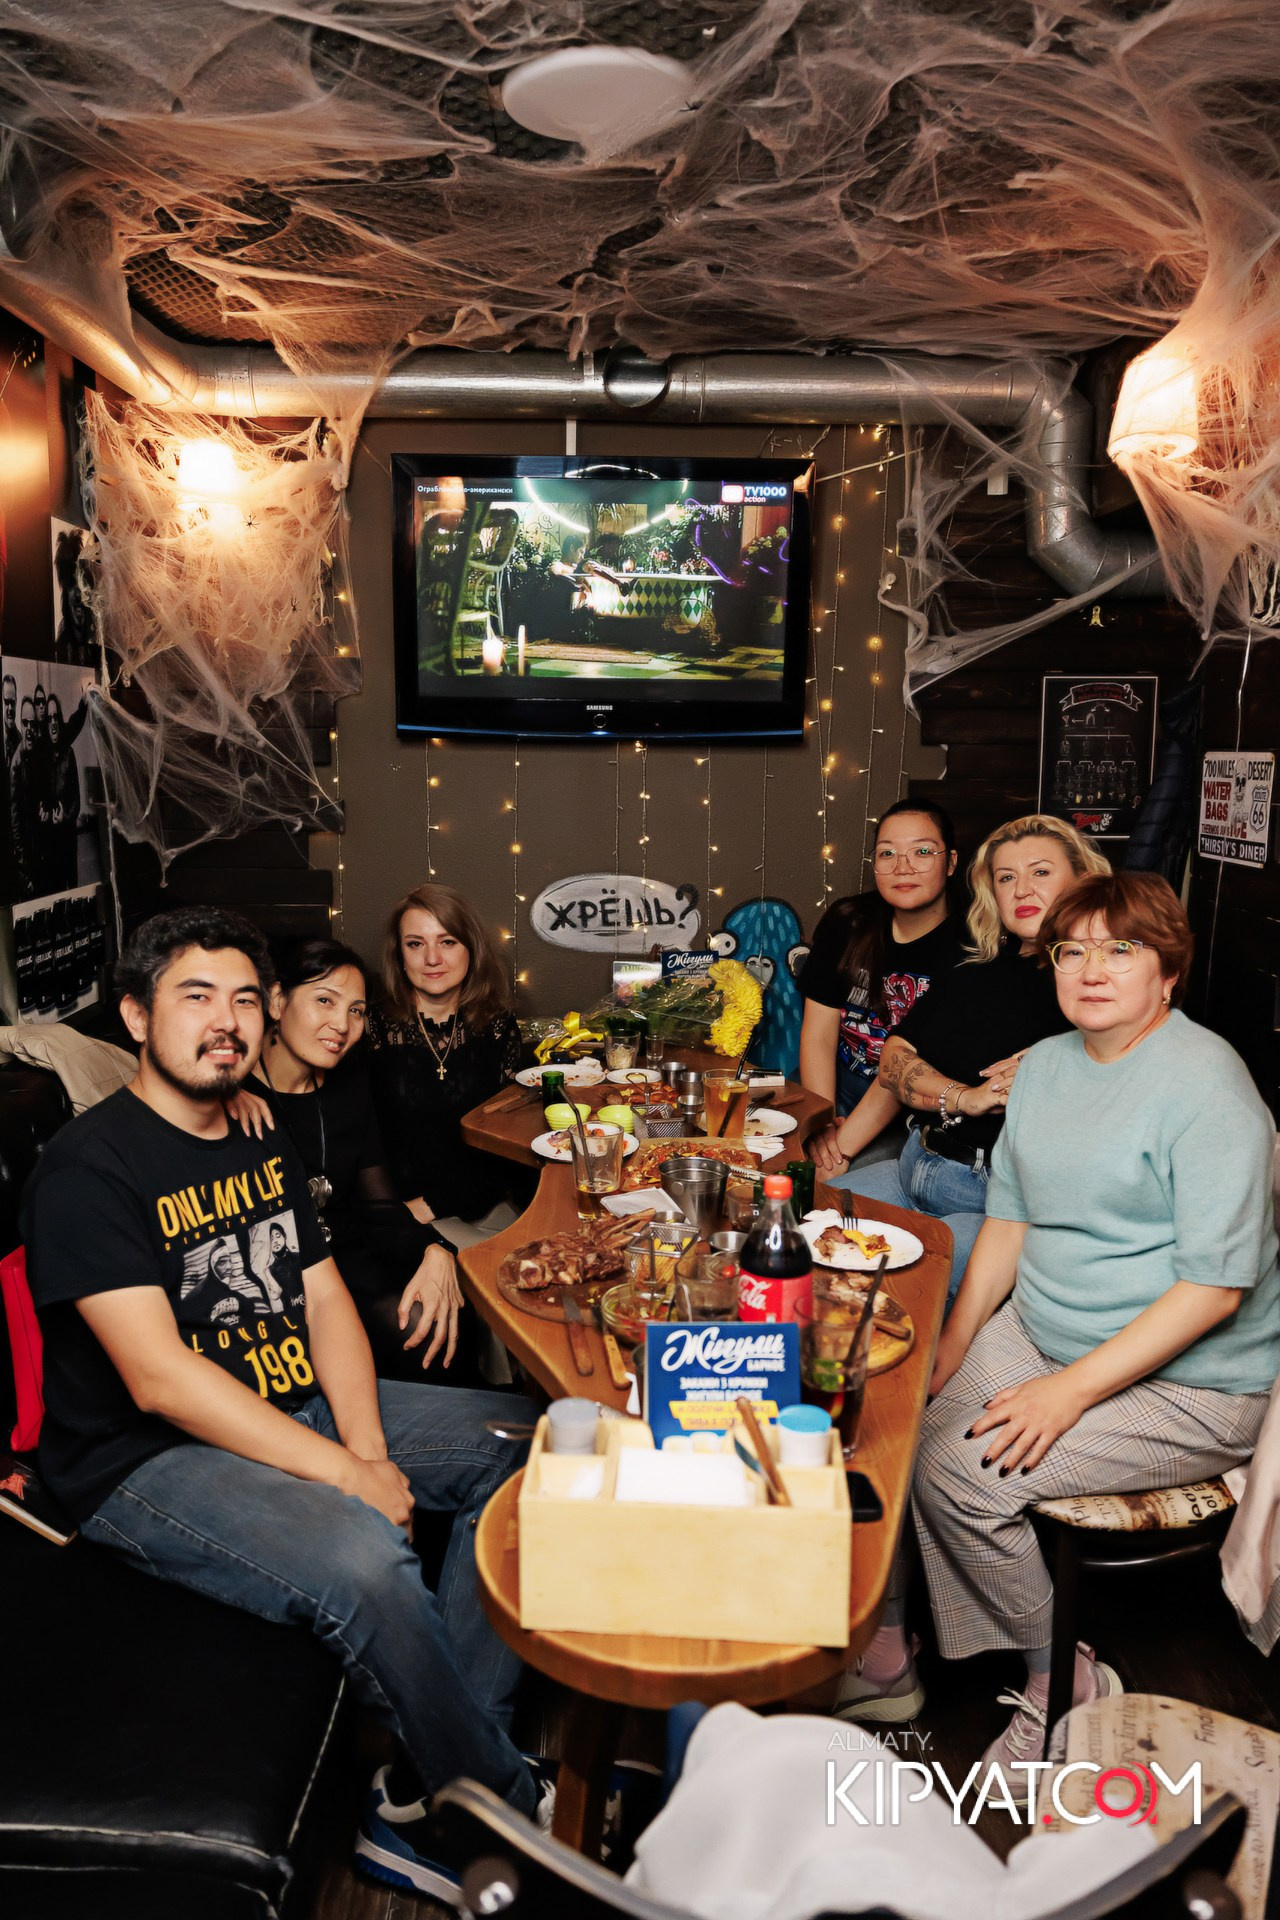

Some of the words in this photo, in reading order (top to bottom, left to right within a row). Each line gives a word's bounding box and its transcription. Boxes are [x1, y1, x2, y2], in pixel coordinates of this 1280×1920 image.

[459, 486, 514, 495] о-американски
[744, 485, 787, 497] TV1000
[744, 495, 767, 503] action
[1204, 760, 1217, 778] 700
[1217, 760, 1236, 779] MILES
[1247, 761, 1274, 781] DESERT
[1203, 781, 1232, 801] WATER
[1254, 790, 1267, 800] ROUTE
[1204, 801, 1229, 822] BAGS
[1252, 803, 1265, 825] 66
[1200, 837, 1237, 857] THIRSTY'S
[1239, 843, 1265, 862] DINER
[213, 1171, 255, 1220] MY
[254, 1156, 285, 1201] LIF
